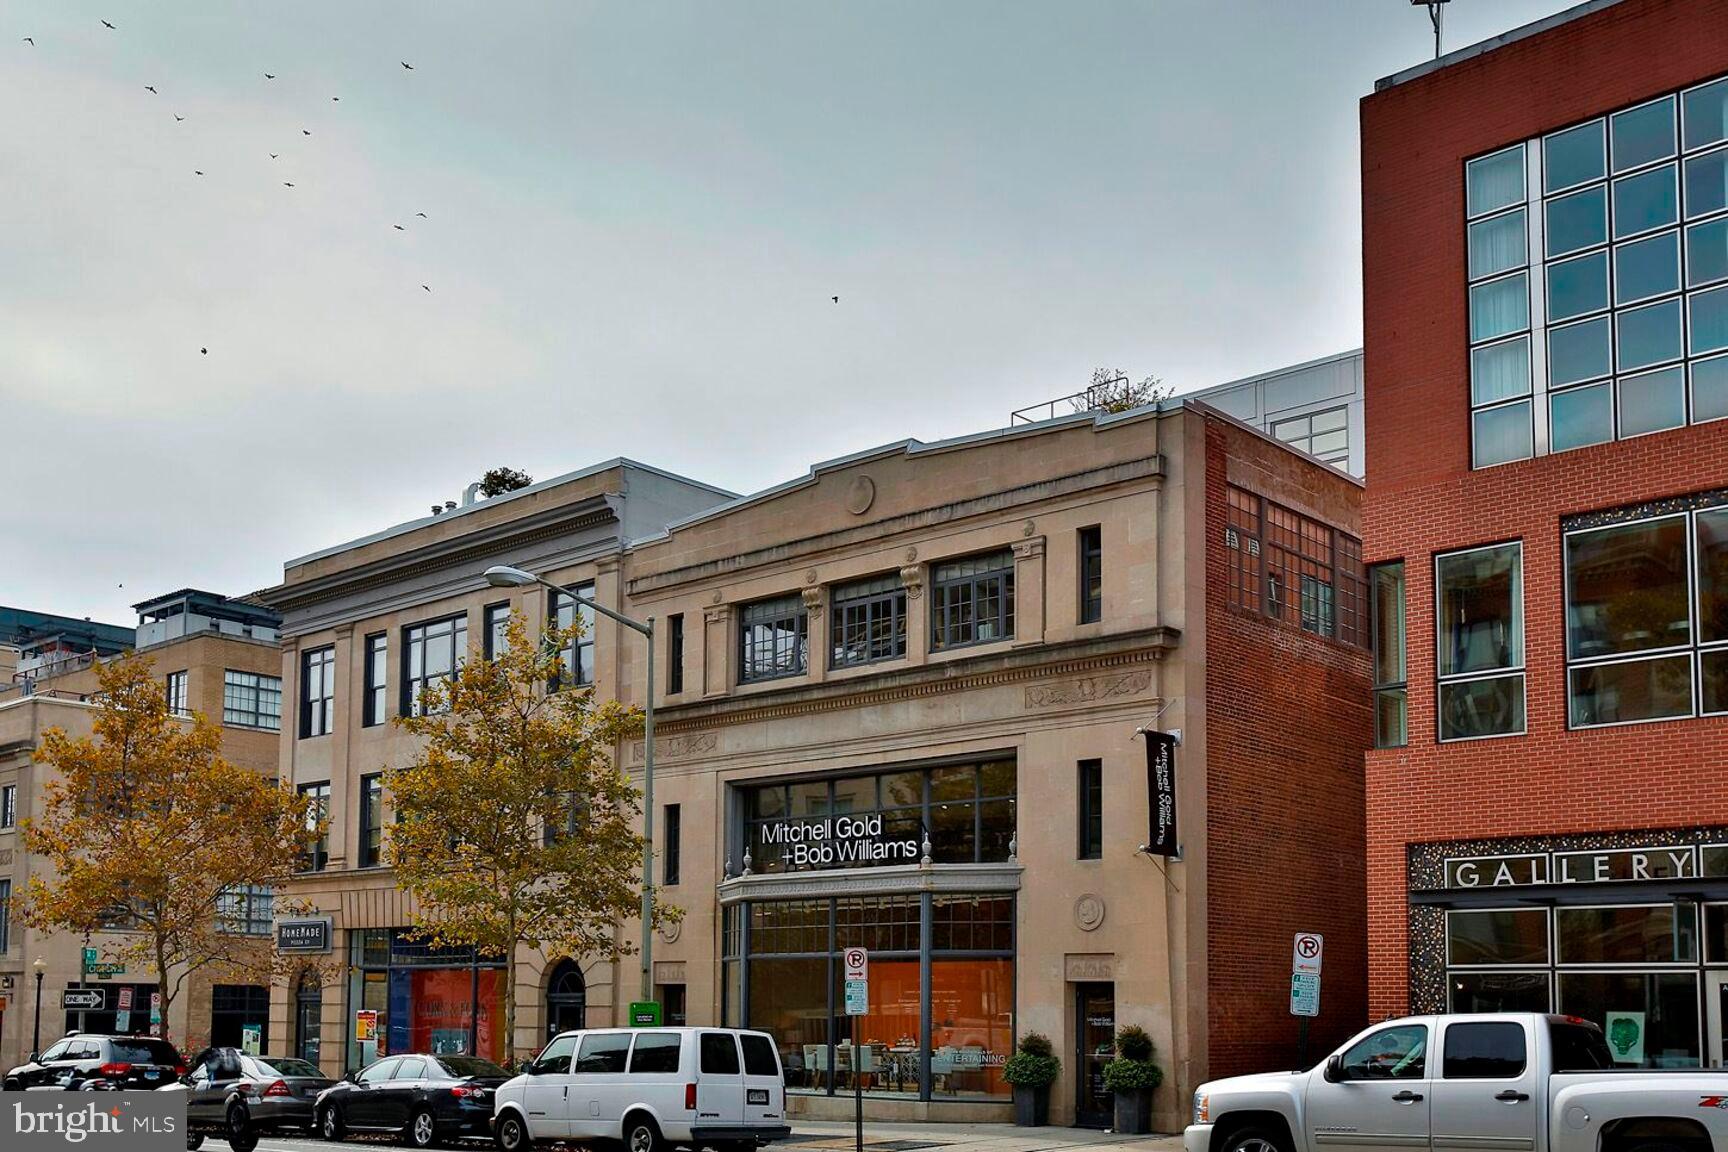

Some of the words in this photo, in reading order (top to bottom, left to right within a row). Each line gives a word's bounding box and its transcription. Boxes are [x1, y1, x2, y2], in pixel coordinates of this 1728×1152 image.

[1155, 756, 1163, 791] +Bob
[1160, 742, 1171, 792] Mitchell
[1157, 792, 1166, 846] Williams
[1164, 794, 1173, 826] Gold
[761, 819, 832, 844] Mitchell
[835, 814, 882, 840] Gold
[781, 840, 834, 865] +Bob
[837, 838, 918, 862] Williams
[1456, 852, 1692, 888] GALLERY
[66, 995, 79, 1003] ONE
[83, 995, 97, 1003] WAY
[937, 1054, 1006, 1064] ENTERTAINING
